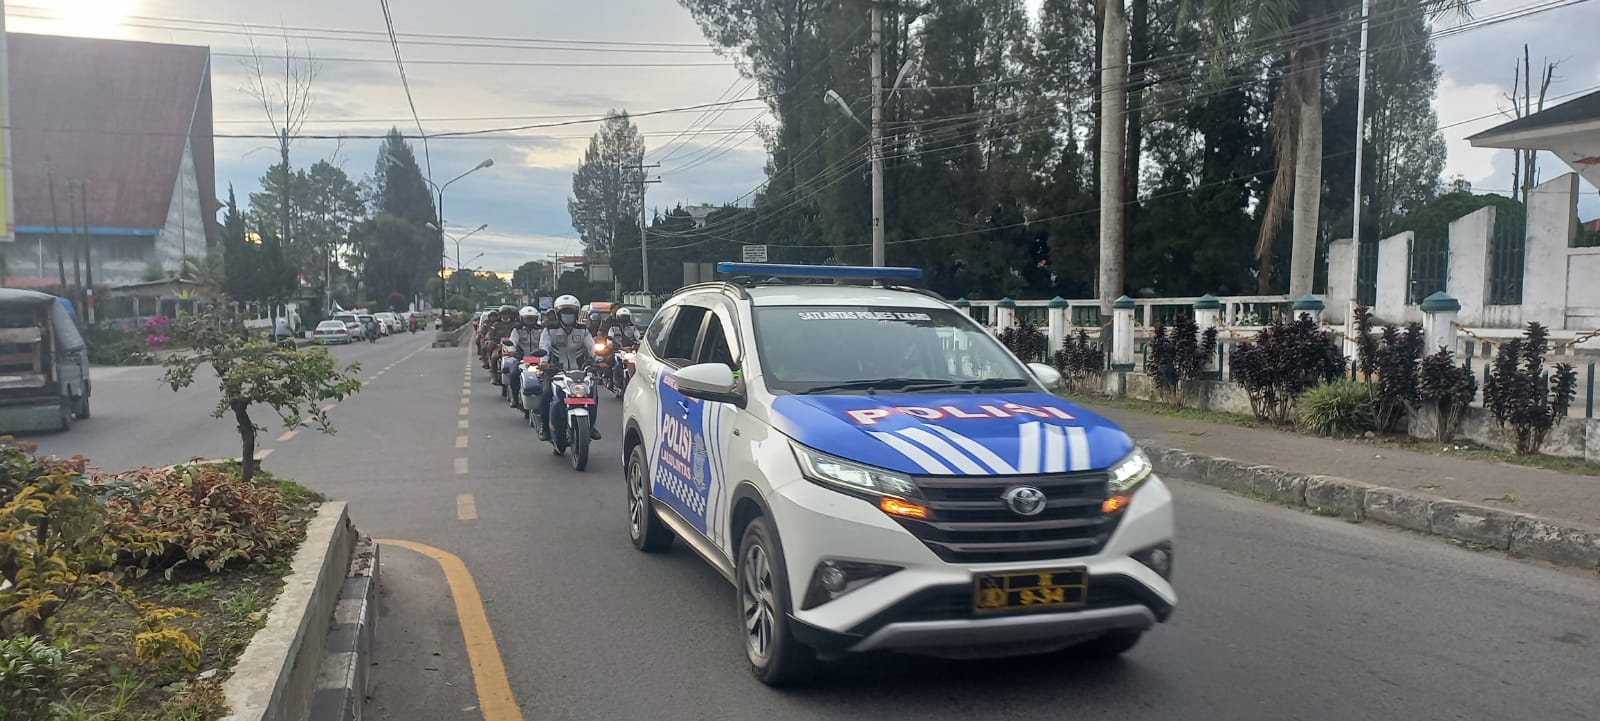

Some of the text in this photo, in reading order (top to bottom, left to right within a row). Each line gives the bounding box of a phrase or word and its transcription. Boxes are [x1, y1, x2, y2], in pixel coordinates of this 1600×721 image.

[798, 311, 856, 321] SATLANTAS
[846, 402, 1075, 426] POLISI
[662, 413, 692, 464] POLISI
